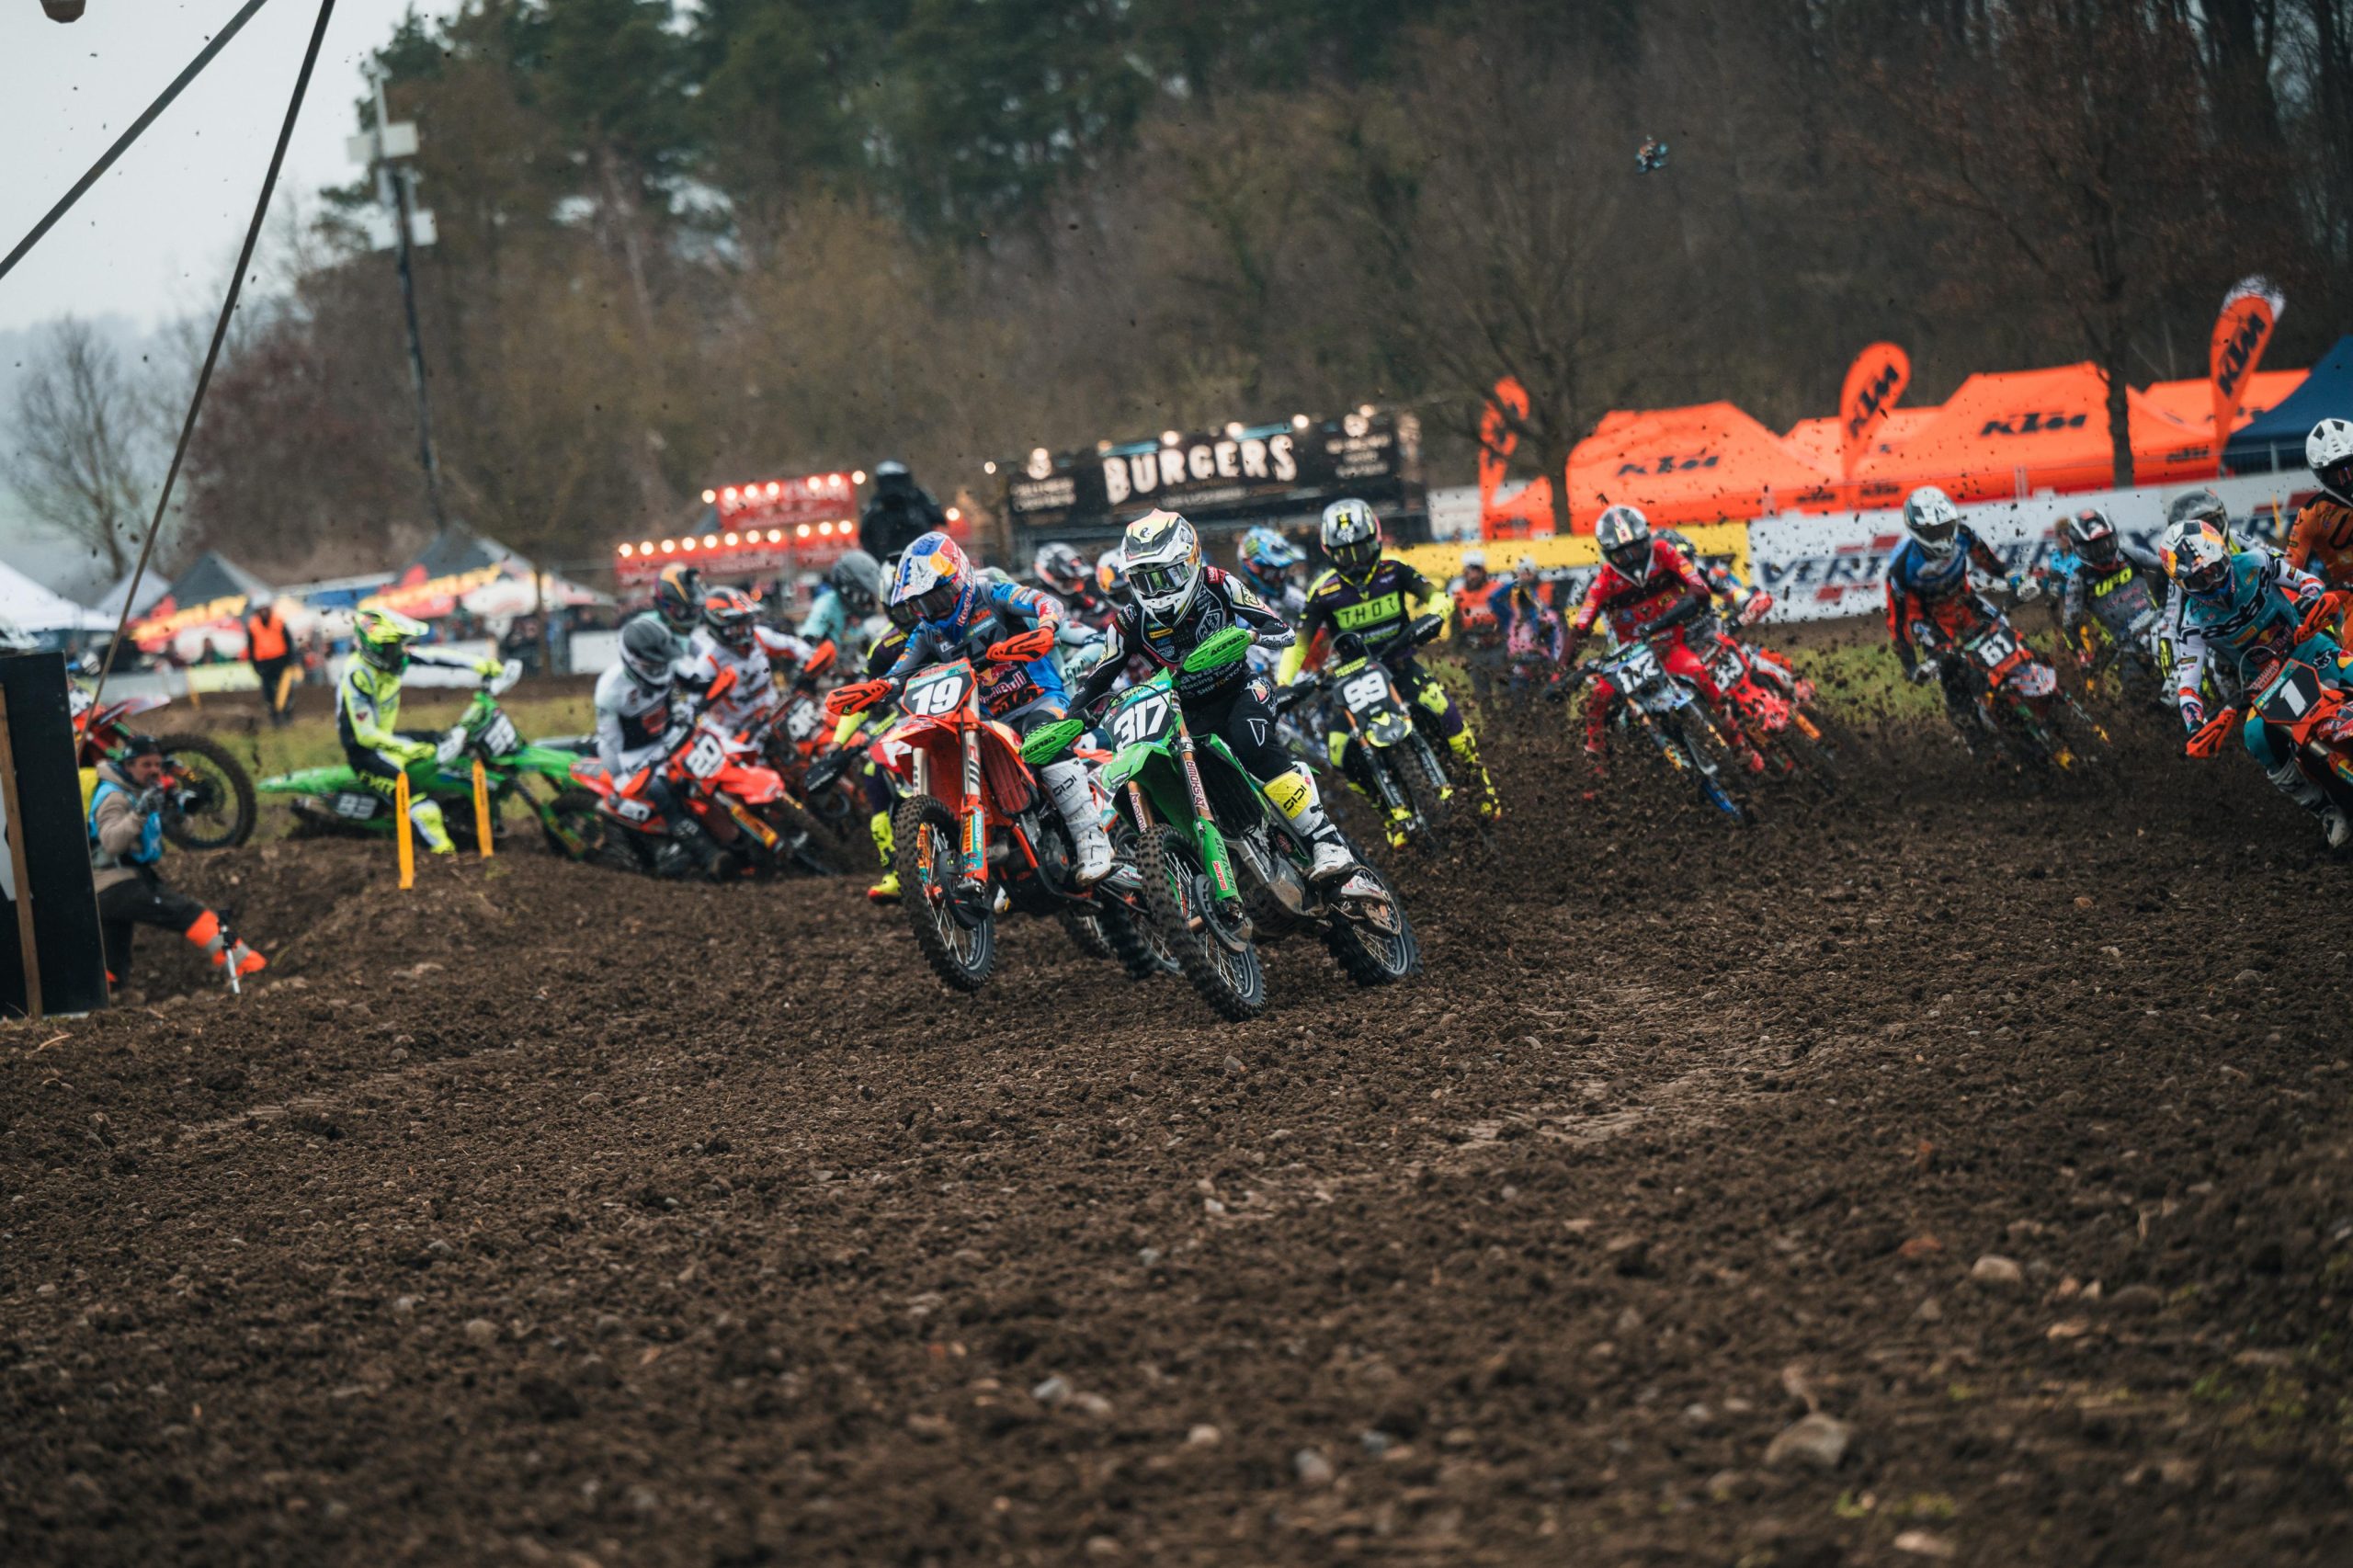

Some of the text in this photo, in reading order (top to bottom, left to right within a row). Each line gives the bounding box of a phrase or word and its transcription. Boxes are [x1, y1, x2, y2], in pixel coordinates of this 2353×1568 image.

[2217, 310, 2266, 399] KTM
[1848, 364, 1899, 438] KTM
[1979, 412, 2086, 437] KTM
[1103, 434, 1297, 506] BURGERS
[2095, 566, 2132, 596] UFO
[1211, 633, 1245, 657] ACERBIS
[1180, 672, 1214, 691] Racing
[1214, 660, 1237, 679] Team
[1343, 671, 1388, 713] 99
[912, 676, 963, 716] 19
[2279, 679, 2308, 717] 1
[1113, 692, 1172, 752] 317
[1025, 736, 1056, 756] ACERBIS
[1051, 775, 1077, 799] SIDI
[1186, 760, 1205, 797] SHOWA
[1283, 784, 1307, 812] SIDI
[1212, 861, 1229, 892] BRAKING
[1214, 837, 1236, 892] DUNLOP
